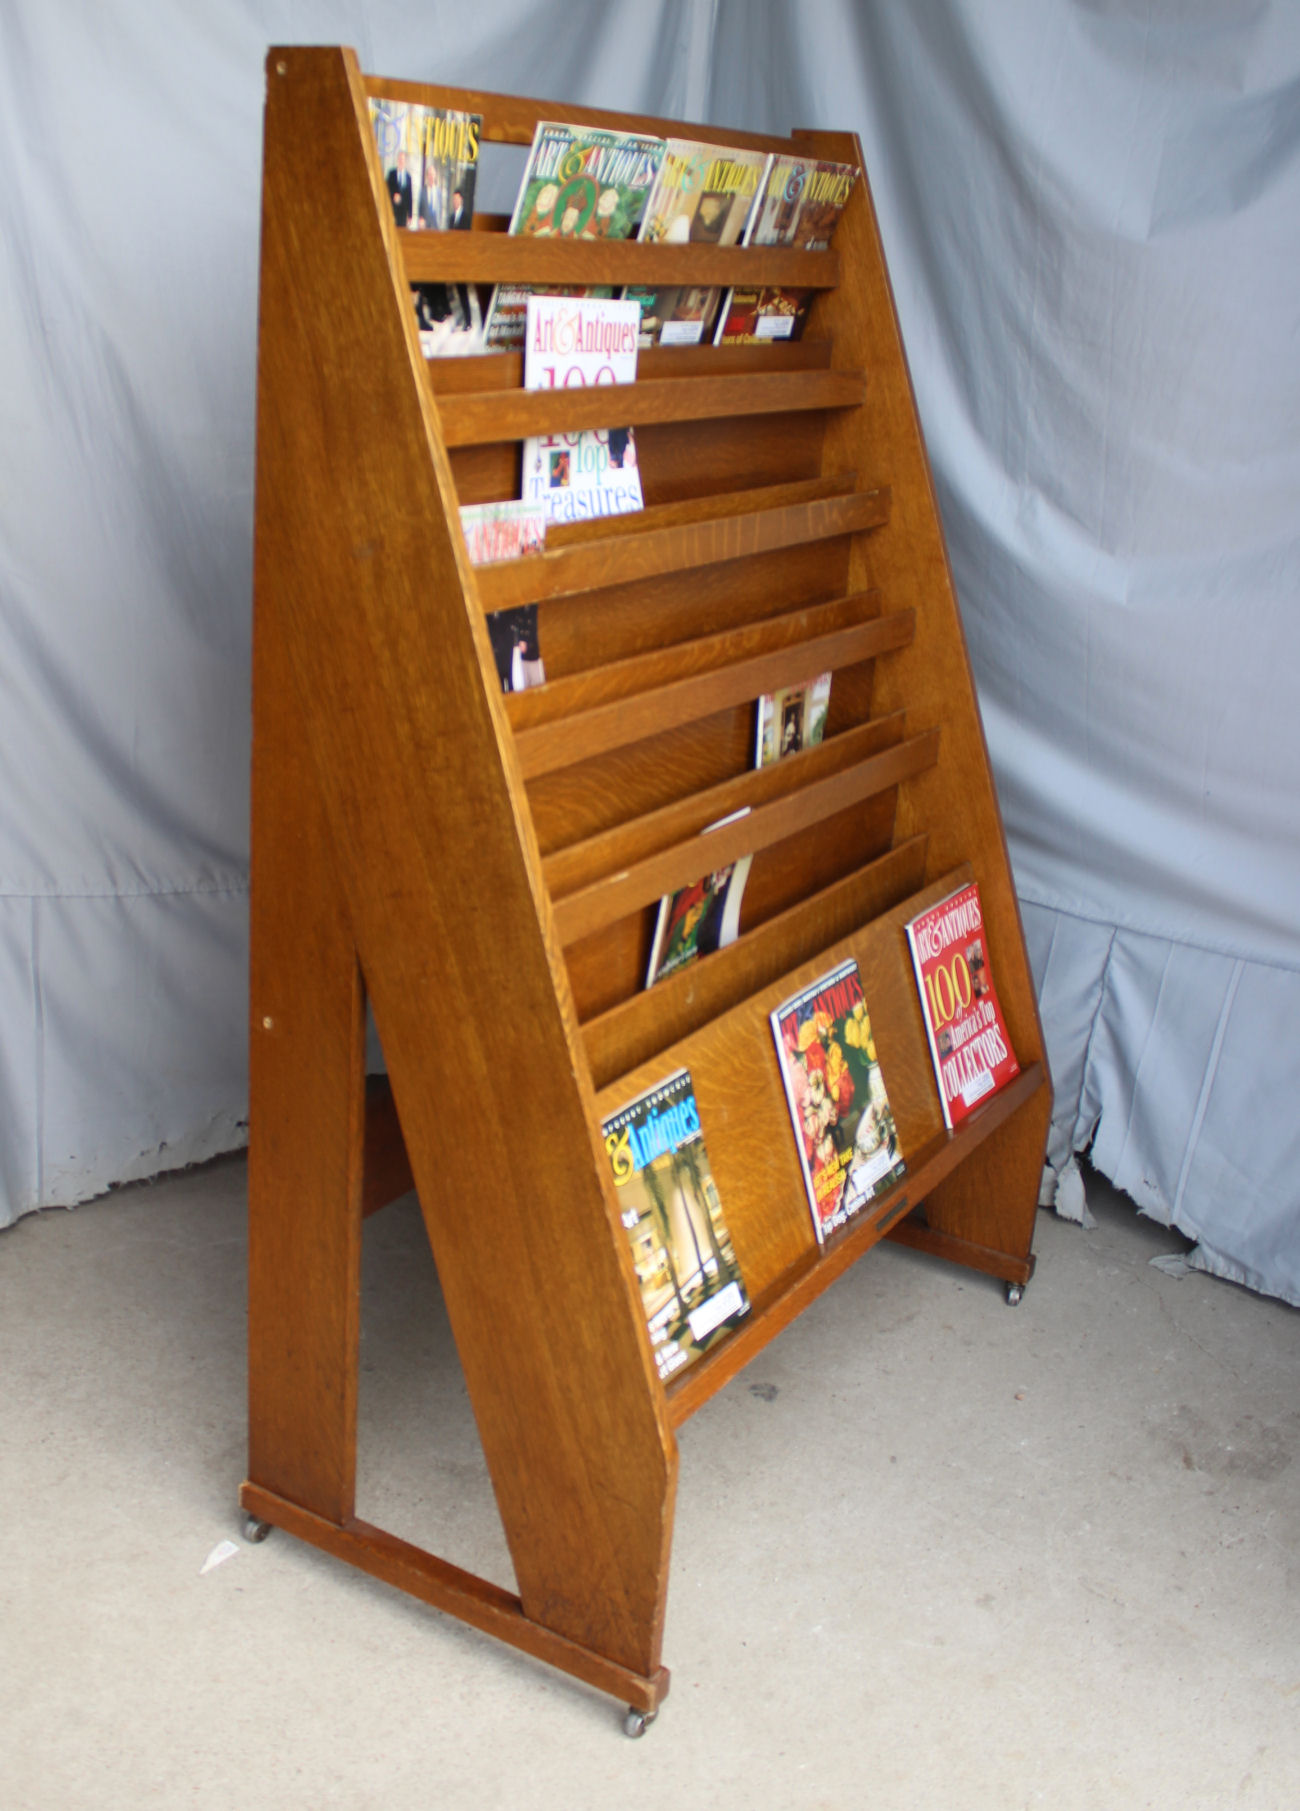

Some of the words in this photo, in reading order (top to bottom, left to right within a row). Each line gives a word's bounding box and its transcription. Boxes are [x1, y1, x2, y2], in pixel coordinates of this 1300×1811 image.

[531, 138, 569, 177] ART
[583, 144, 660, 189] ANTIQUES
[534, 308, 554, 353] Art
[574, 308, 636, 360] Antiques
[529, 476, 640, 520] Teasures
[940, 897, 981, 949] ANTIQUES
[925, 952, 972, 1032] 100
[950, 1007, 983, 1050] America's
[977, 1000, 996, 1026] Top
[942, 1023, 1008, 1102] COLLECTORS
[626, 1095, 701, 1172] Antiques
